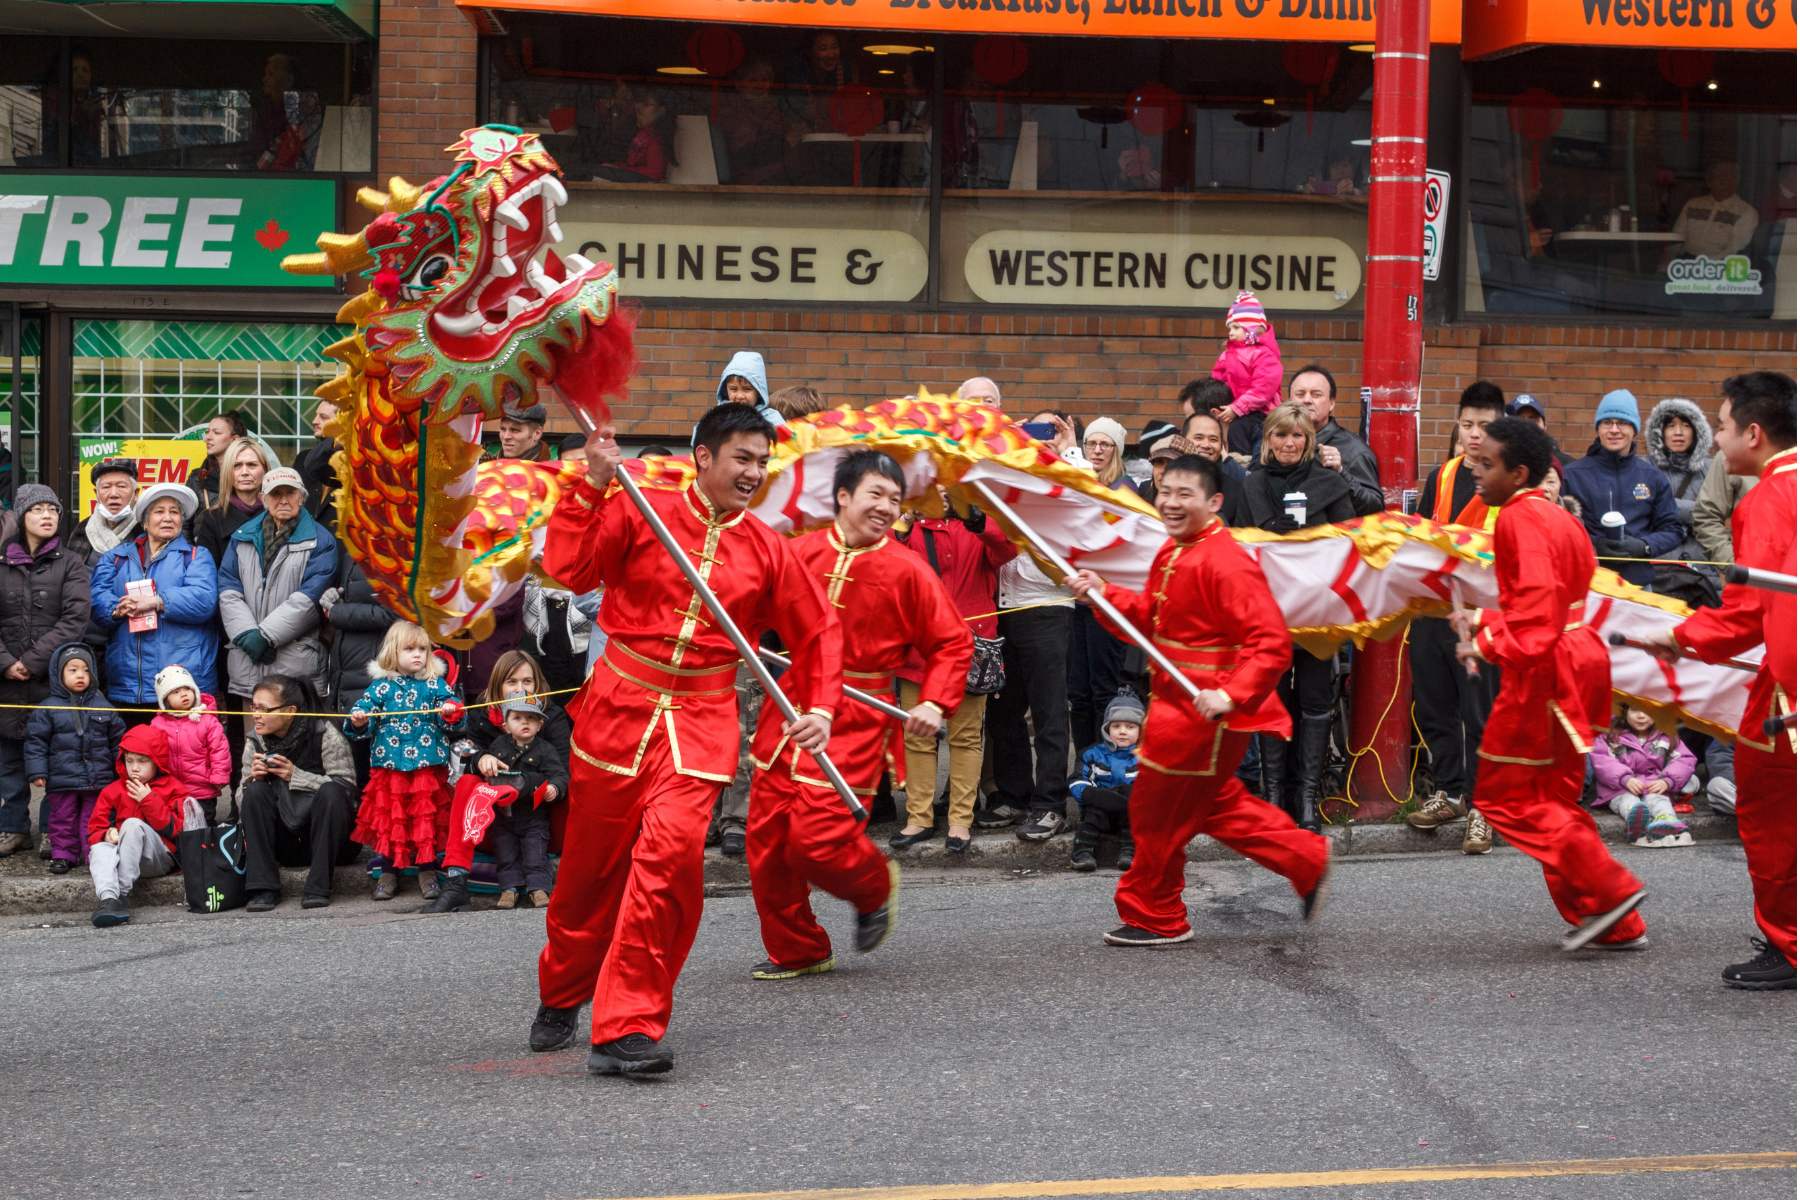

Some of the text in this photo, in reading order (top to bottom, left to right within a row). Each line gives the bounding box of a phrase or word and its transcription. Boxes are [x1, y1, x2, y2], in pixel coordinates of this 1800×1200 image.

[1581, 0, 1733, 28] Western
[0, 194, 243, 269] TREE
[845, 248, 884, 286] &
[989, 249, 1336, 291] WESTERN CUISINE
[133, 297, 154, 306] 173
[1668, 284, 1691, 292] great
[81, 441, 118, 458] WOW!
[103, 457, 190, 484] EM
